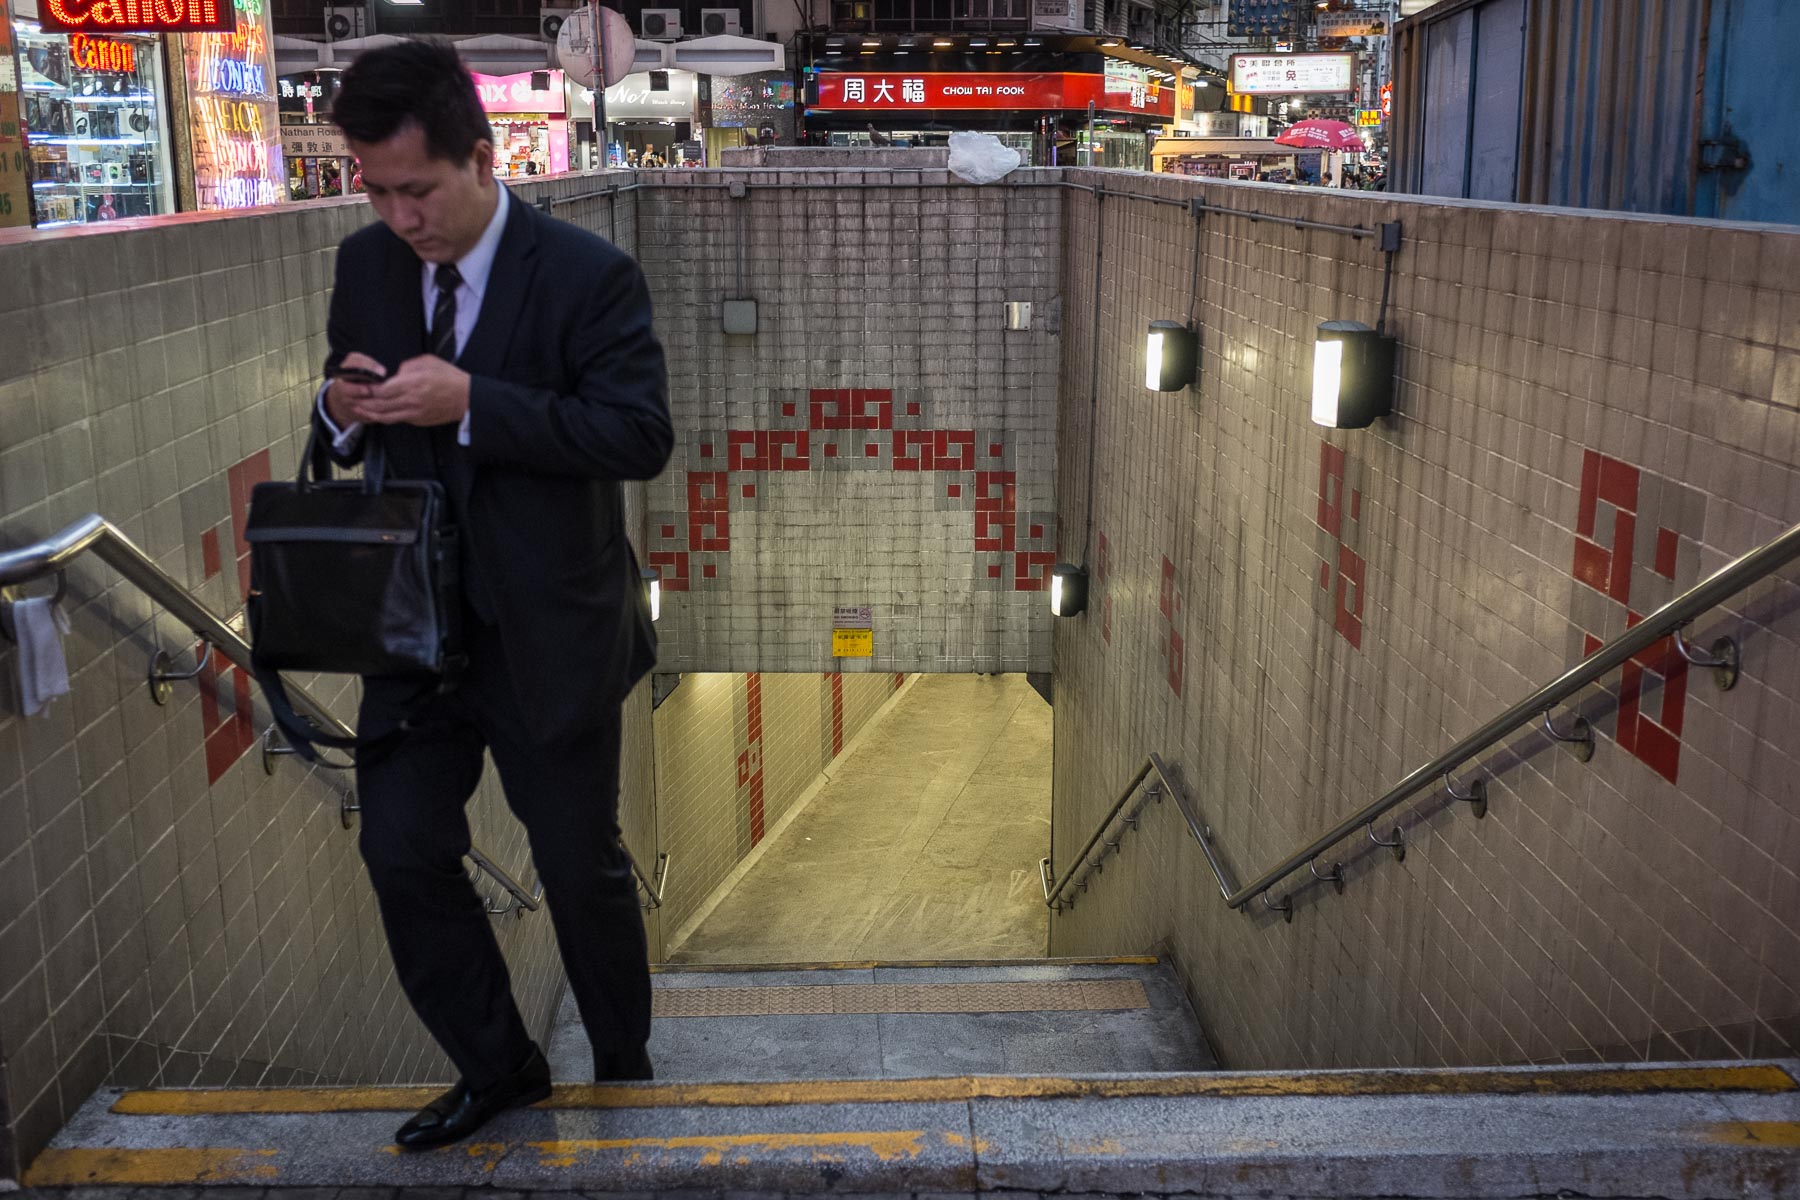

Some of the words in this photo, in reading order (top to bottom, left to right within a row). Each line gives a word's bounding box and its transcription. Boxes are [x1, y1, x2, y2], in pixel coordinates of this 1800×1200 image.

[46, 0, 217, 24] Canon
[72, 33, 135, 72] Canon
[843, 78, 925, 103] 周大福
[942, 86, 972, 95] CHOW
[975, 86, 992, 95] TAI
[996, 86, 1025, 95] FOOK
[280, 128, 314, 137] Nathan
[317, 128, 343, 137] Road
[291, 141, 333, 153] 彌敦道
